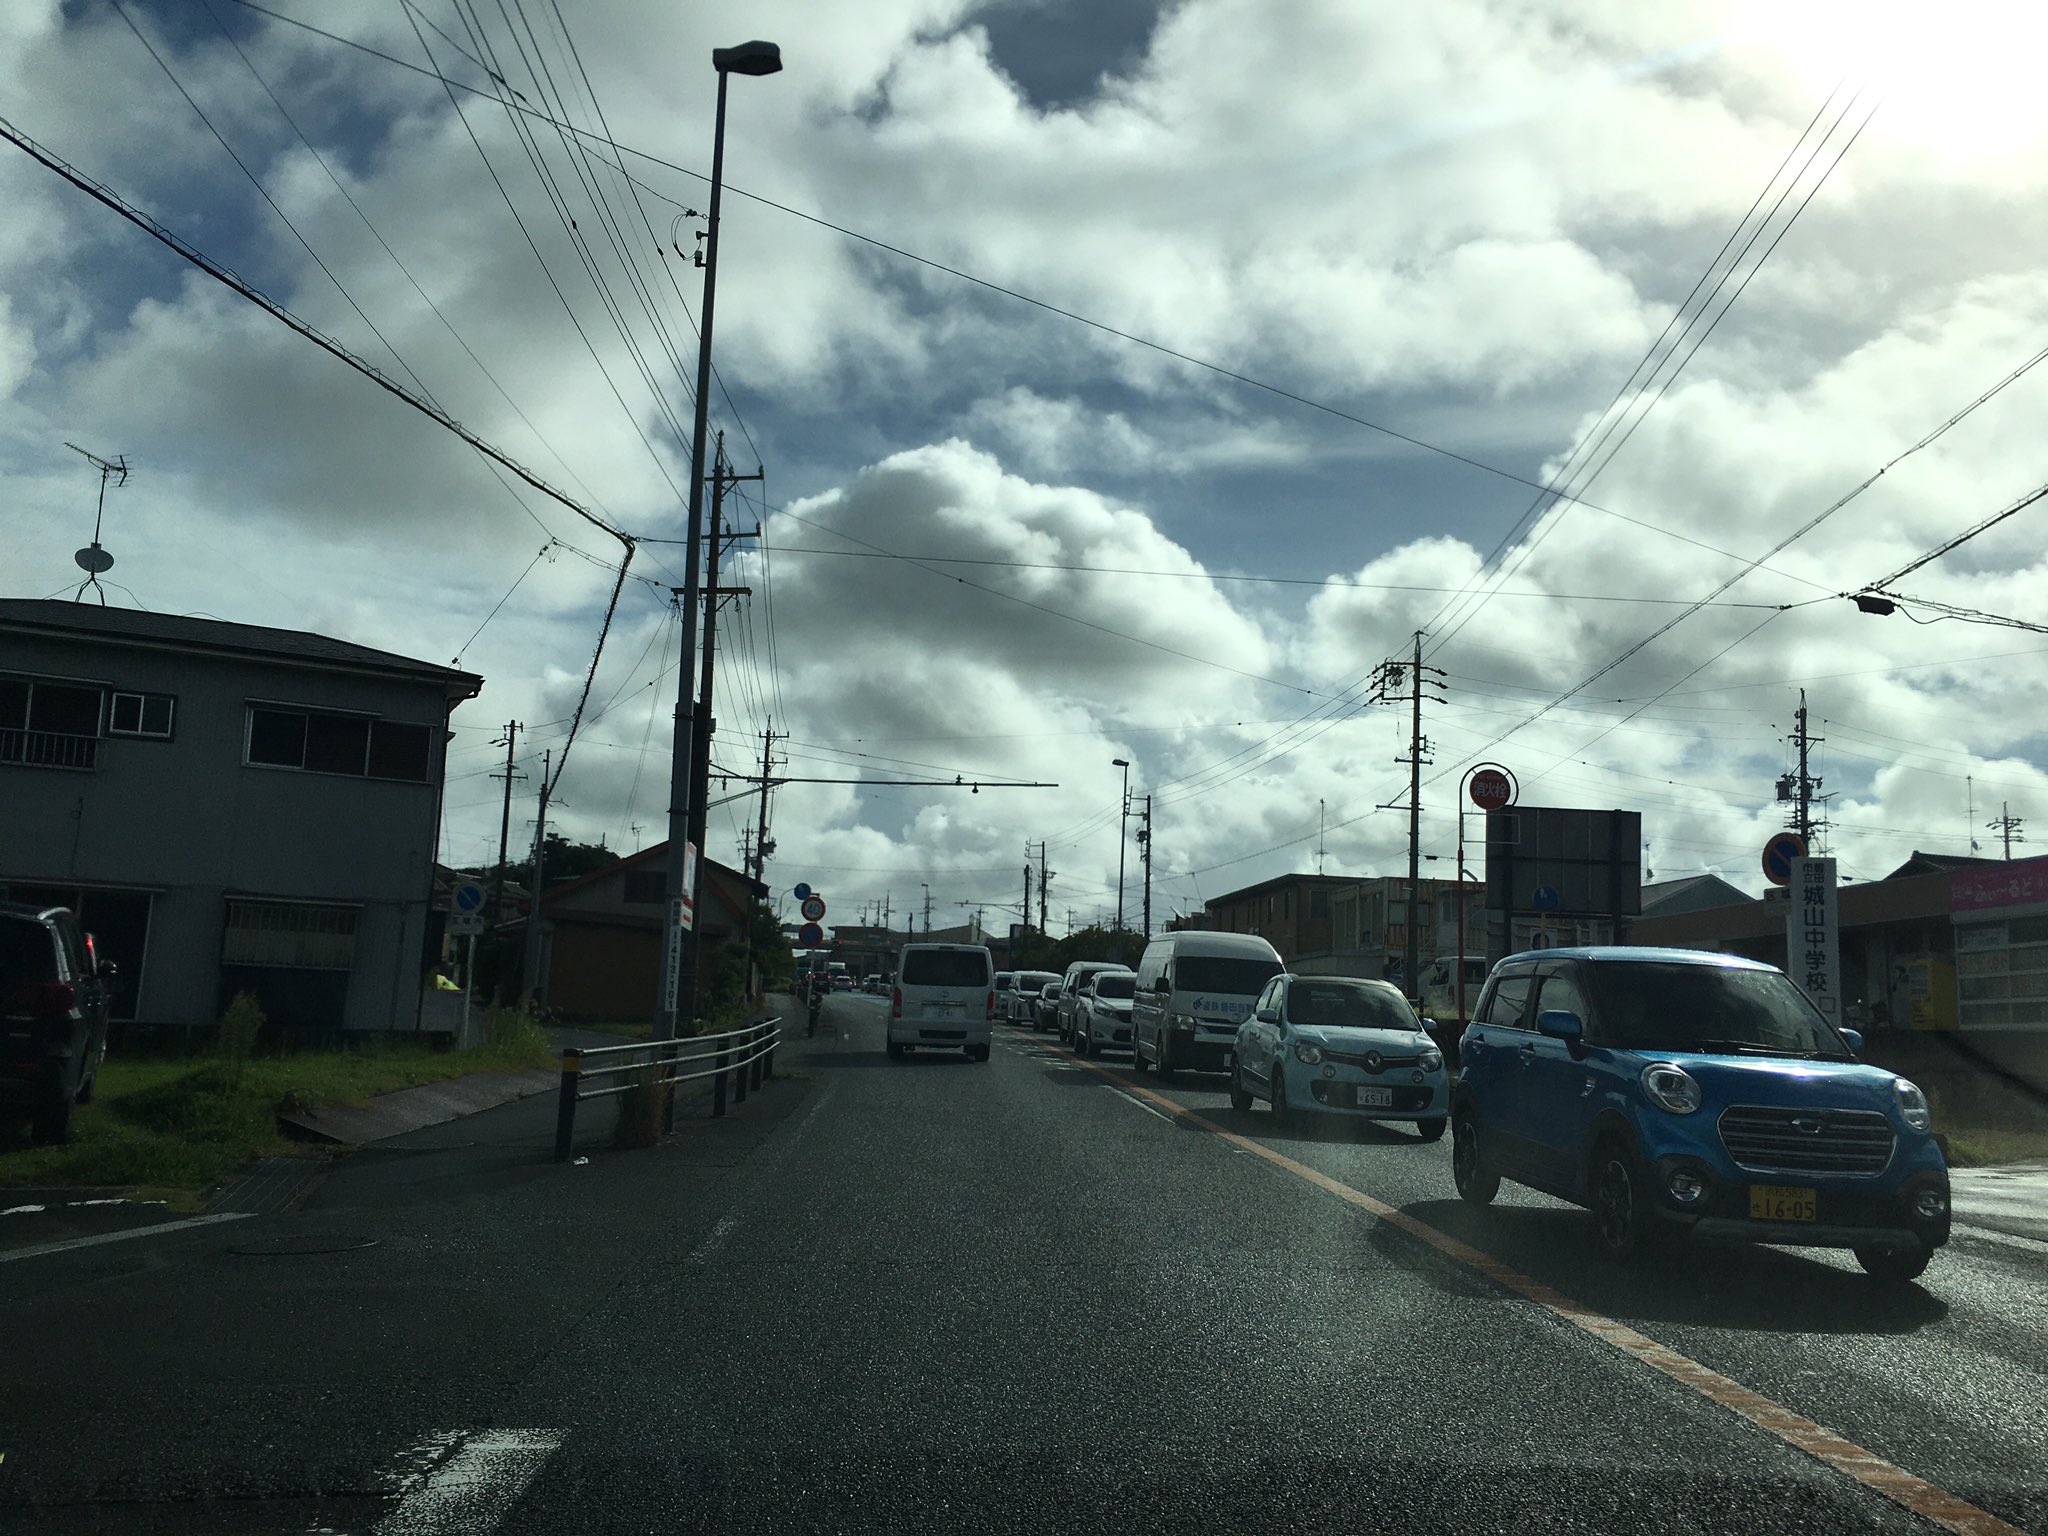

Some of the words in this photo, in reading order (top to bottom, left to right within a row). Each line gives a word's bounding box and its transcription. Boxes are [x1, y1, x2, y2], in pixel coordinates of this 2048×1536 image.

[1474, 781, 1507, 799] 消火栓
[807, 902, 821, 916] 40
[1803, 884, 1827, 992] 城山中学校
[1765, 1198, 1815, 1219] 16-05
